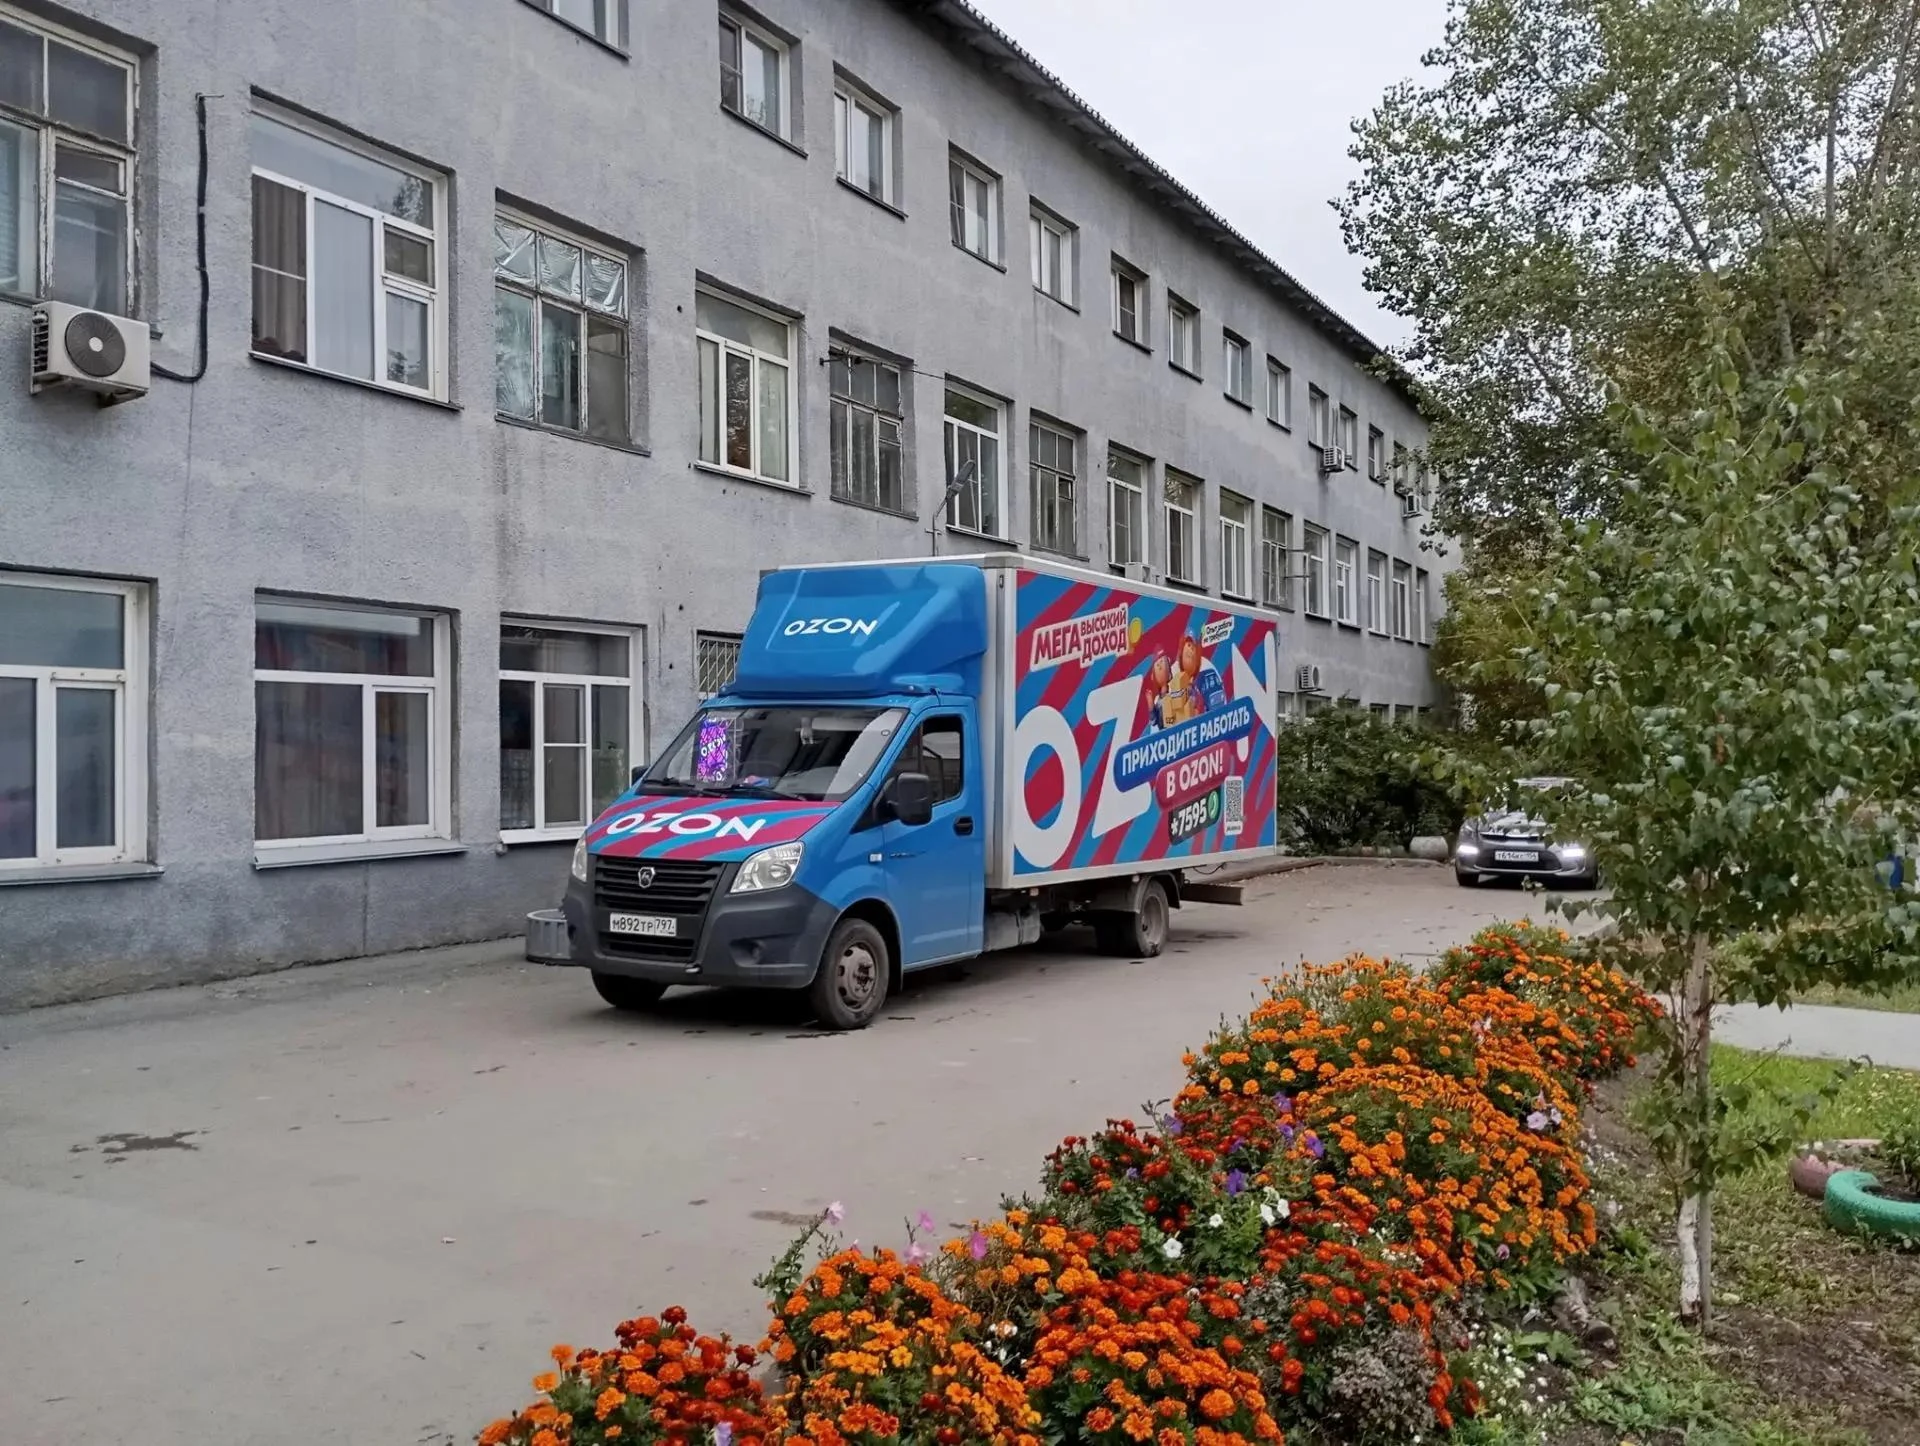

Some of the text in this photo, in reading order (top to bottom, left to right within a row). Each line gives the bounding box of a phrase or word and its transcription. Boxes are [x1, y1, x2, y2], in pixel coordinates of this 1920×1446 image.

[784, 617, 878, 636] OZON
[1080, 607, 1127, 637] ВЫСОКИЙ
[1034, 623, 1080, 665] МЕГА
[1081, 628, 1127, 664] ДОХОД
[1014, 630, 1276, 868] OZN
[1122, 706, 1250, 776] ПРИХОДИТЕ РАБОТАТЬ
[1166, 748, 1224, 799] В OZON!
[606, 812, 767, 841] OZON
[612, 916, 654, 933] М892ТР
